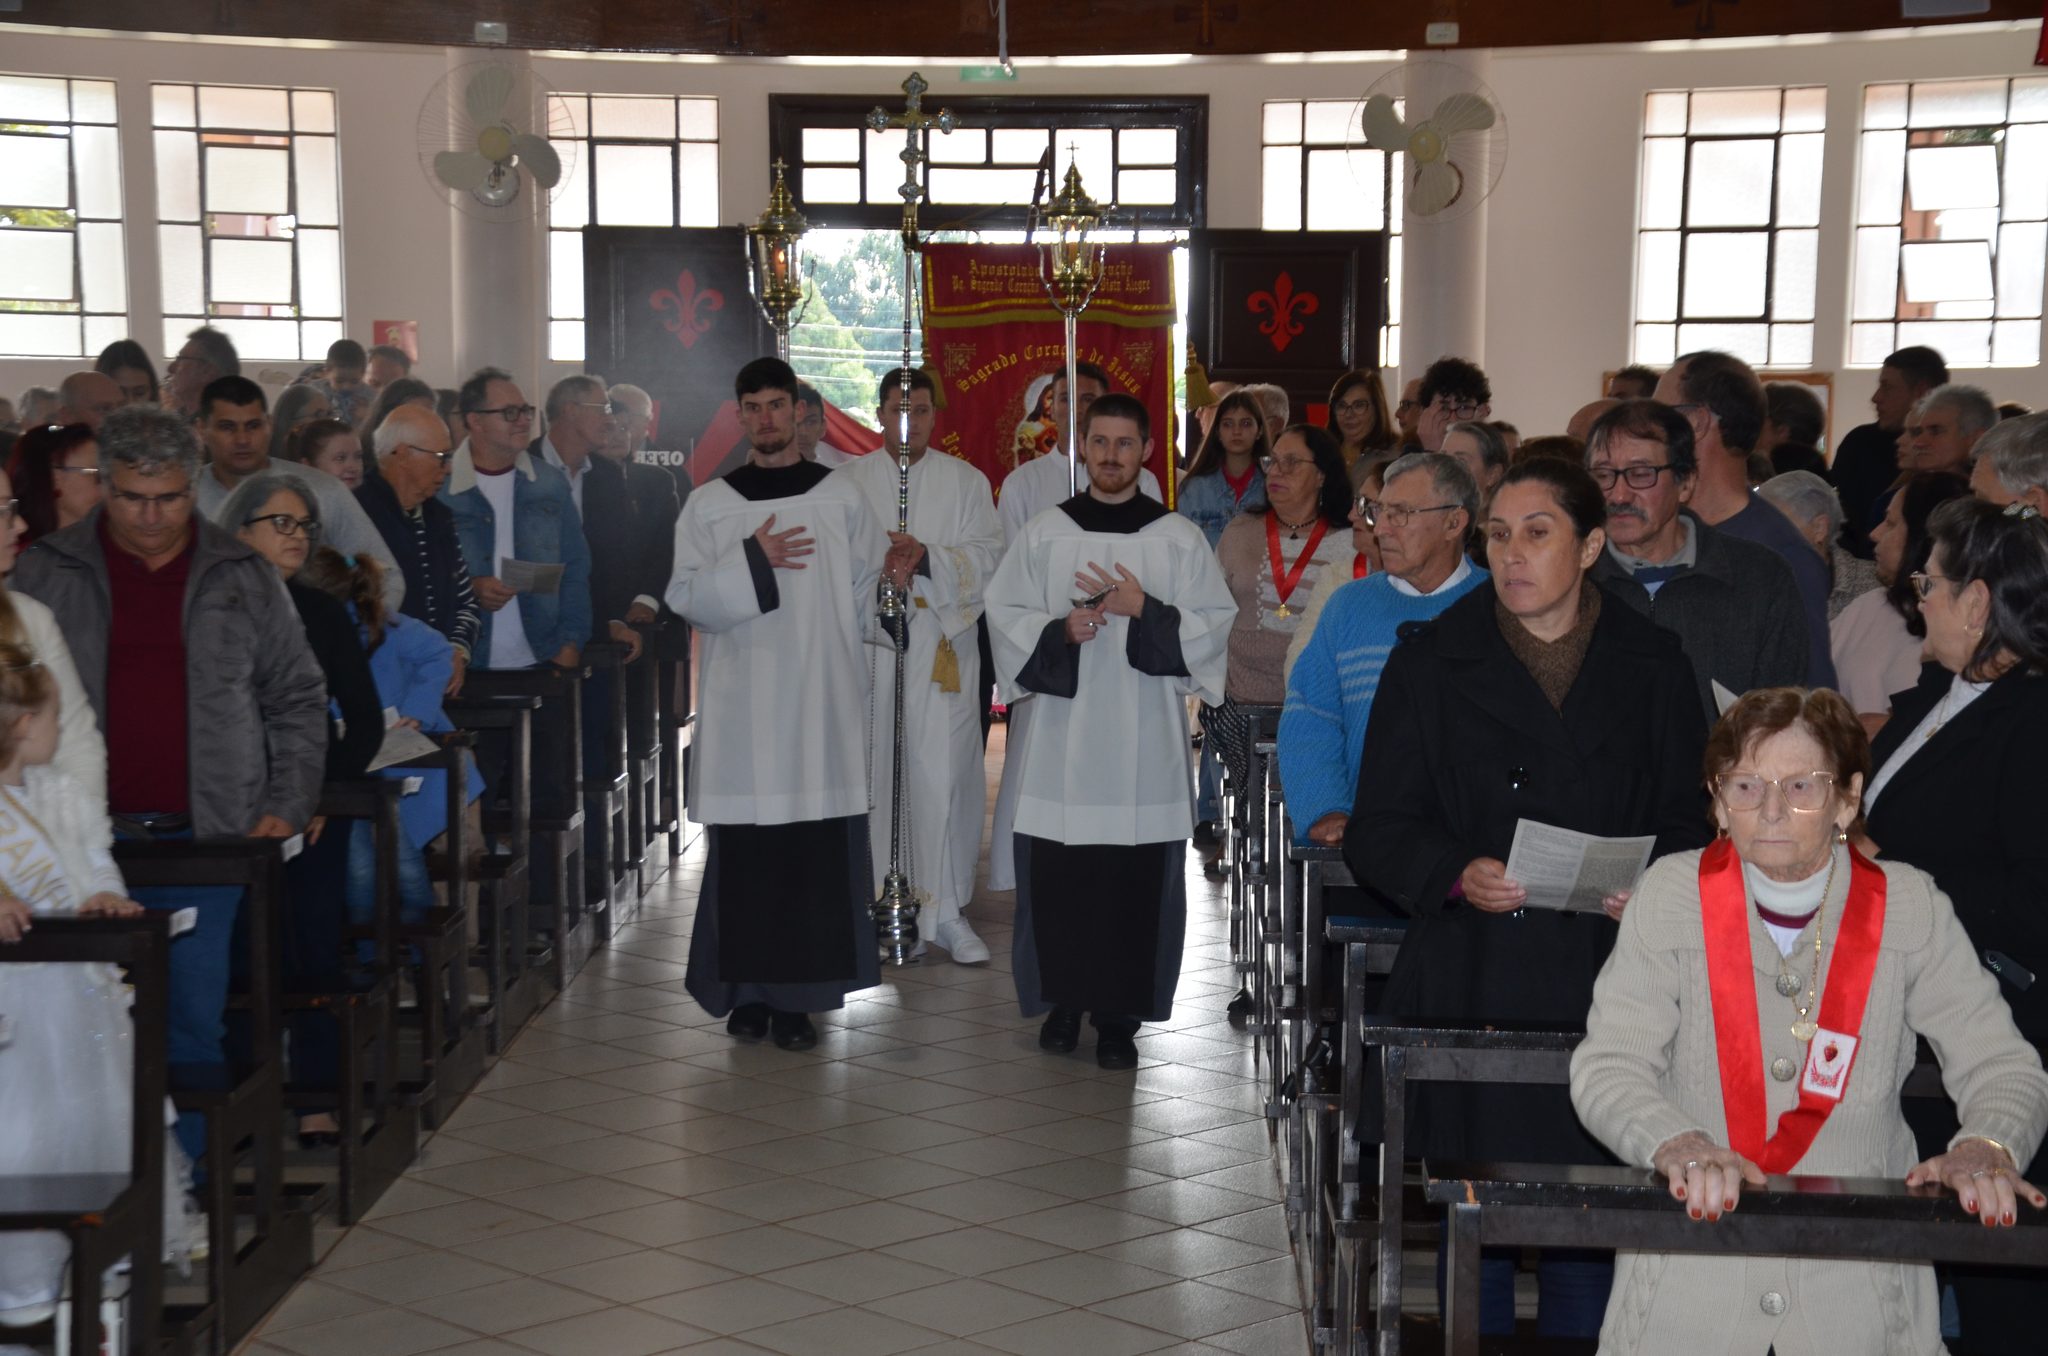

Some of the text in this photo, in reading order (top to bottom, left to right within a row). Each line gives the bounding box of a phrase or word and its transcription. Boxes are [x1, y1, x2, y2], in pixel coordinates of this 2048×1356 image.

[969, 259, 1040, 277] Apostolado
[957, 345, 1141, 393] Sagrado Coraço de Jesus
